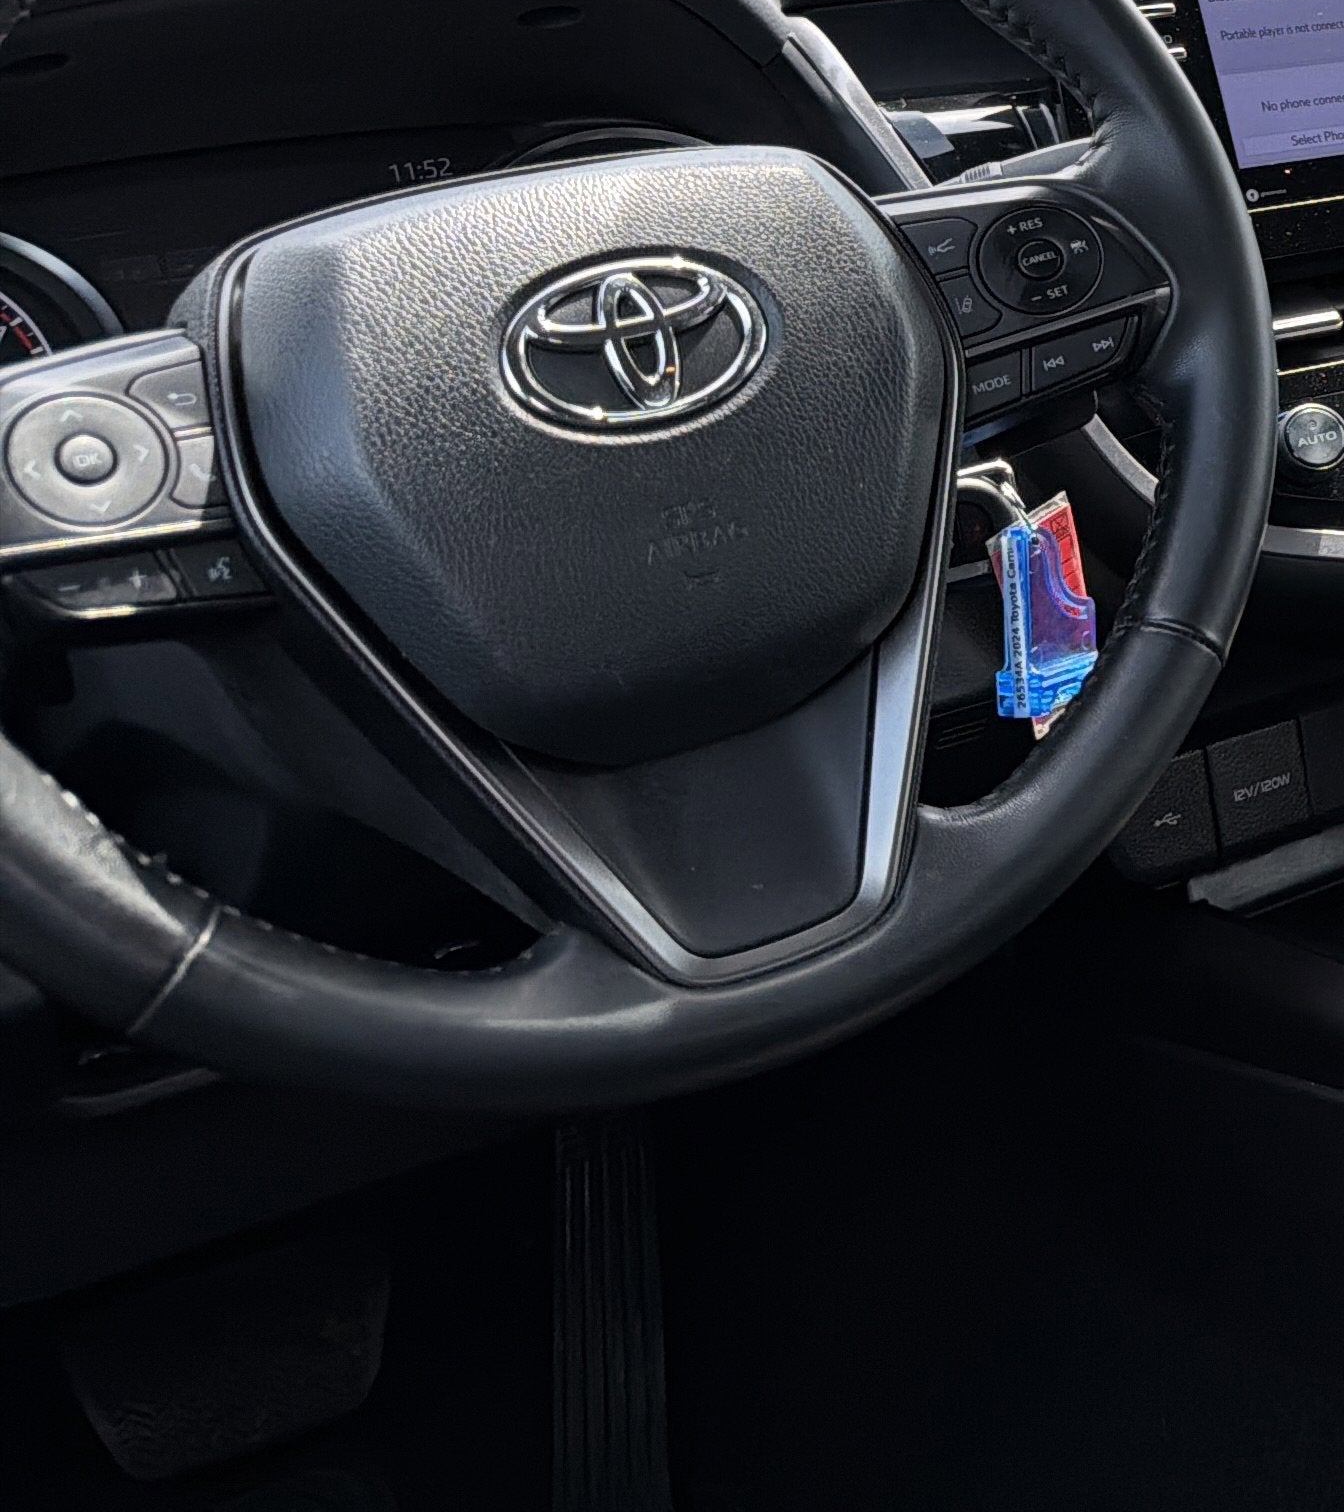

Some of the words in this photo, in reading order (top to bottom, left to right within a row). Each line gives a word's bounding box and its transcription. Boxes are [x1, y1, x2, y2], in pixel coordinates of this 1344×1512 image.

[1220, 25, 1257, 40] Portable
[1258, 25, 1284, 39] player
[1295, 23, 1310, 34] not
[1261, 100, 1278, 112] No
[1279, 97, 1311, 112] phone
[1291, 131, 1323, 147] Select
[388, 157, 453, 183] 11:52
[1019, 217, 1044, 233] RES
[1022, 250, 1059, 267] CANCEL
[1046, 284, 1069, 300] SET
[972, 374, 1013, 395] MODE
[1297, 430, 1338, 448] AUTO
[72, 452, 101, 468] OK
[1010, 579, 1023, 625] Toyota
[1011, 627, 1025, 663] 2024
[1232, 772, 1291, 803] 12V/120W
